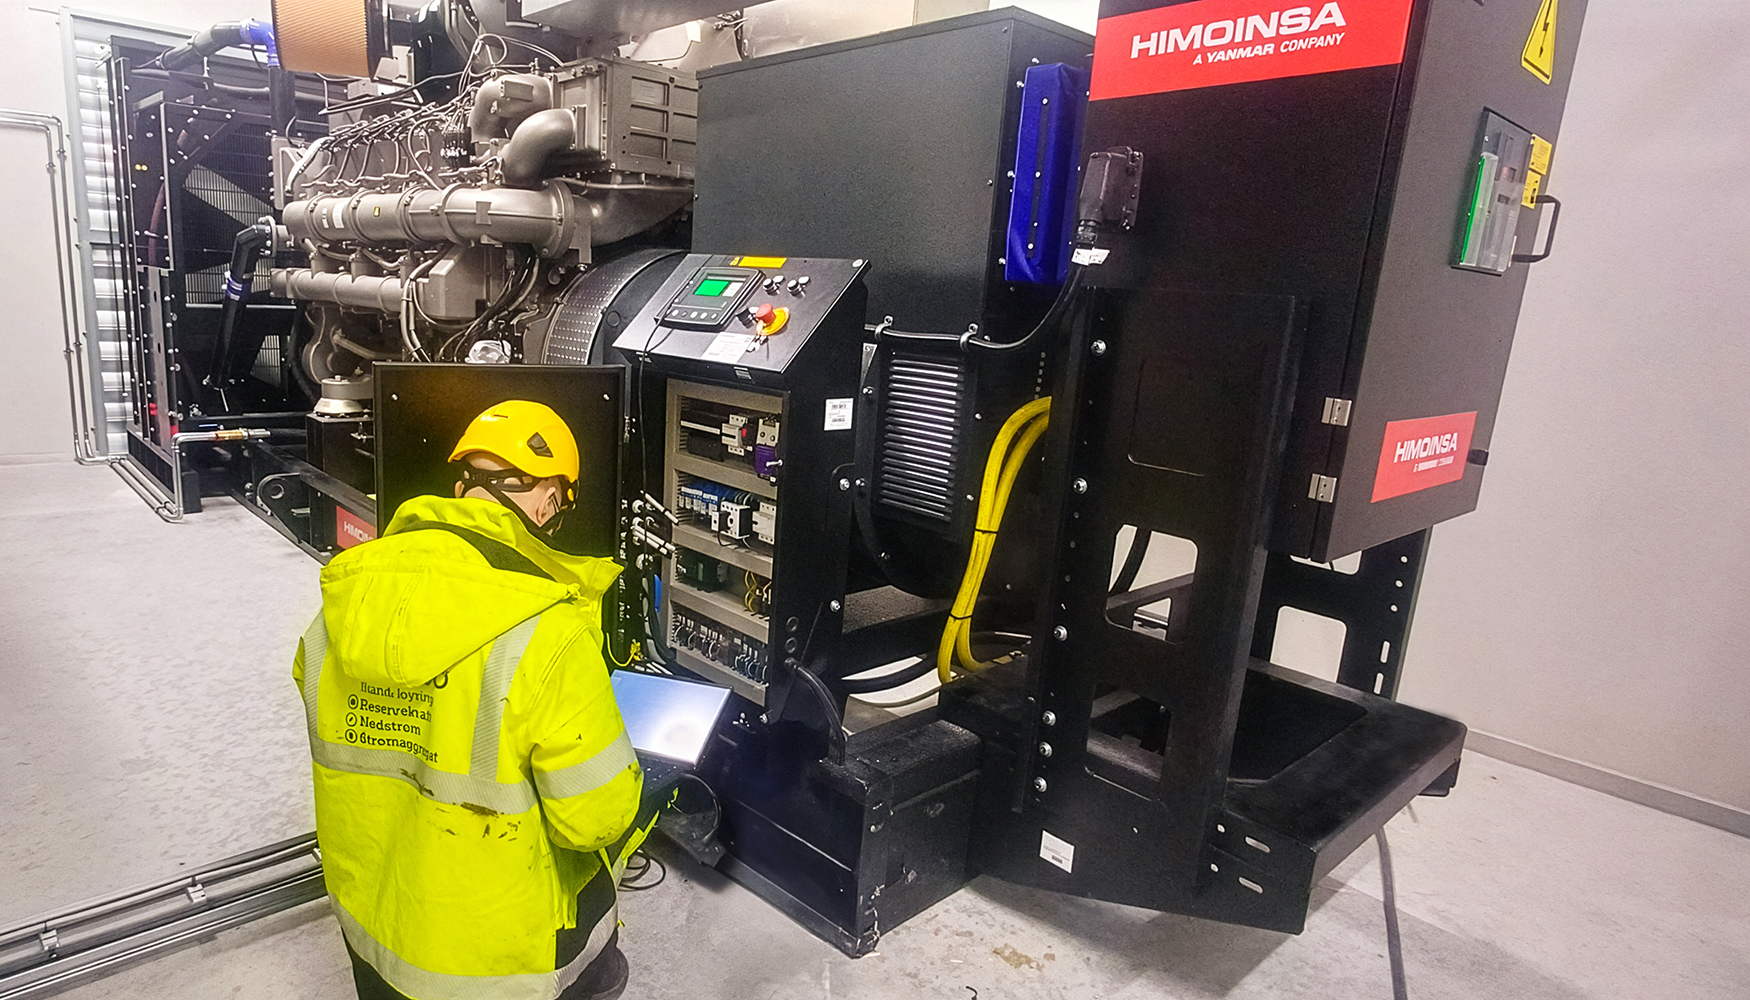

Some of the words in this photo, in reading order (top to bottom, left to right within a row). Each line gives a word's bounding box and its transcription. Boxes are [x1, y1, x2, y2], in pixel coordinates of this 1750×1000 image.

[1131, 2, 1346, 58] HIMOINSA
[1193, 54, 1202, 65] A
[1207, 43, 1275, 63] YANMAR
[1394, 433, 1458, 463] HIMOINSA
